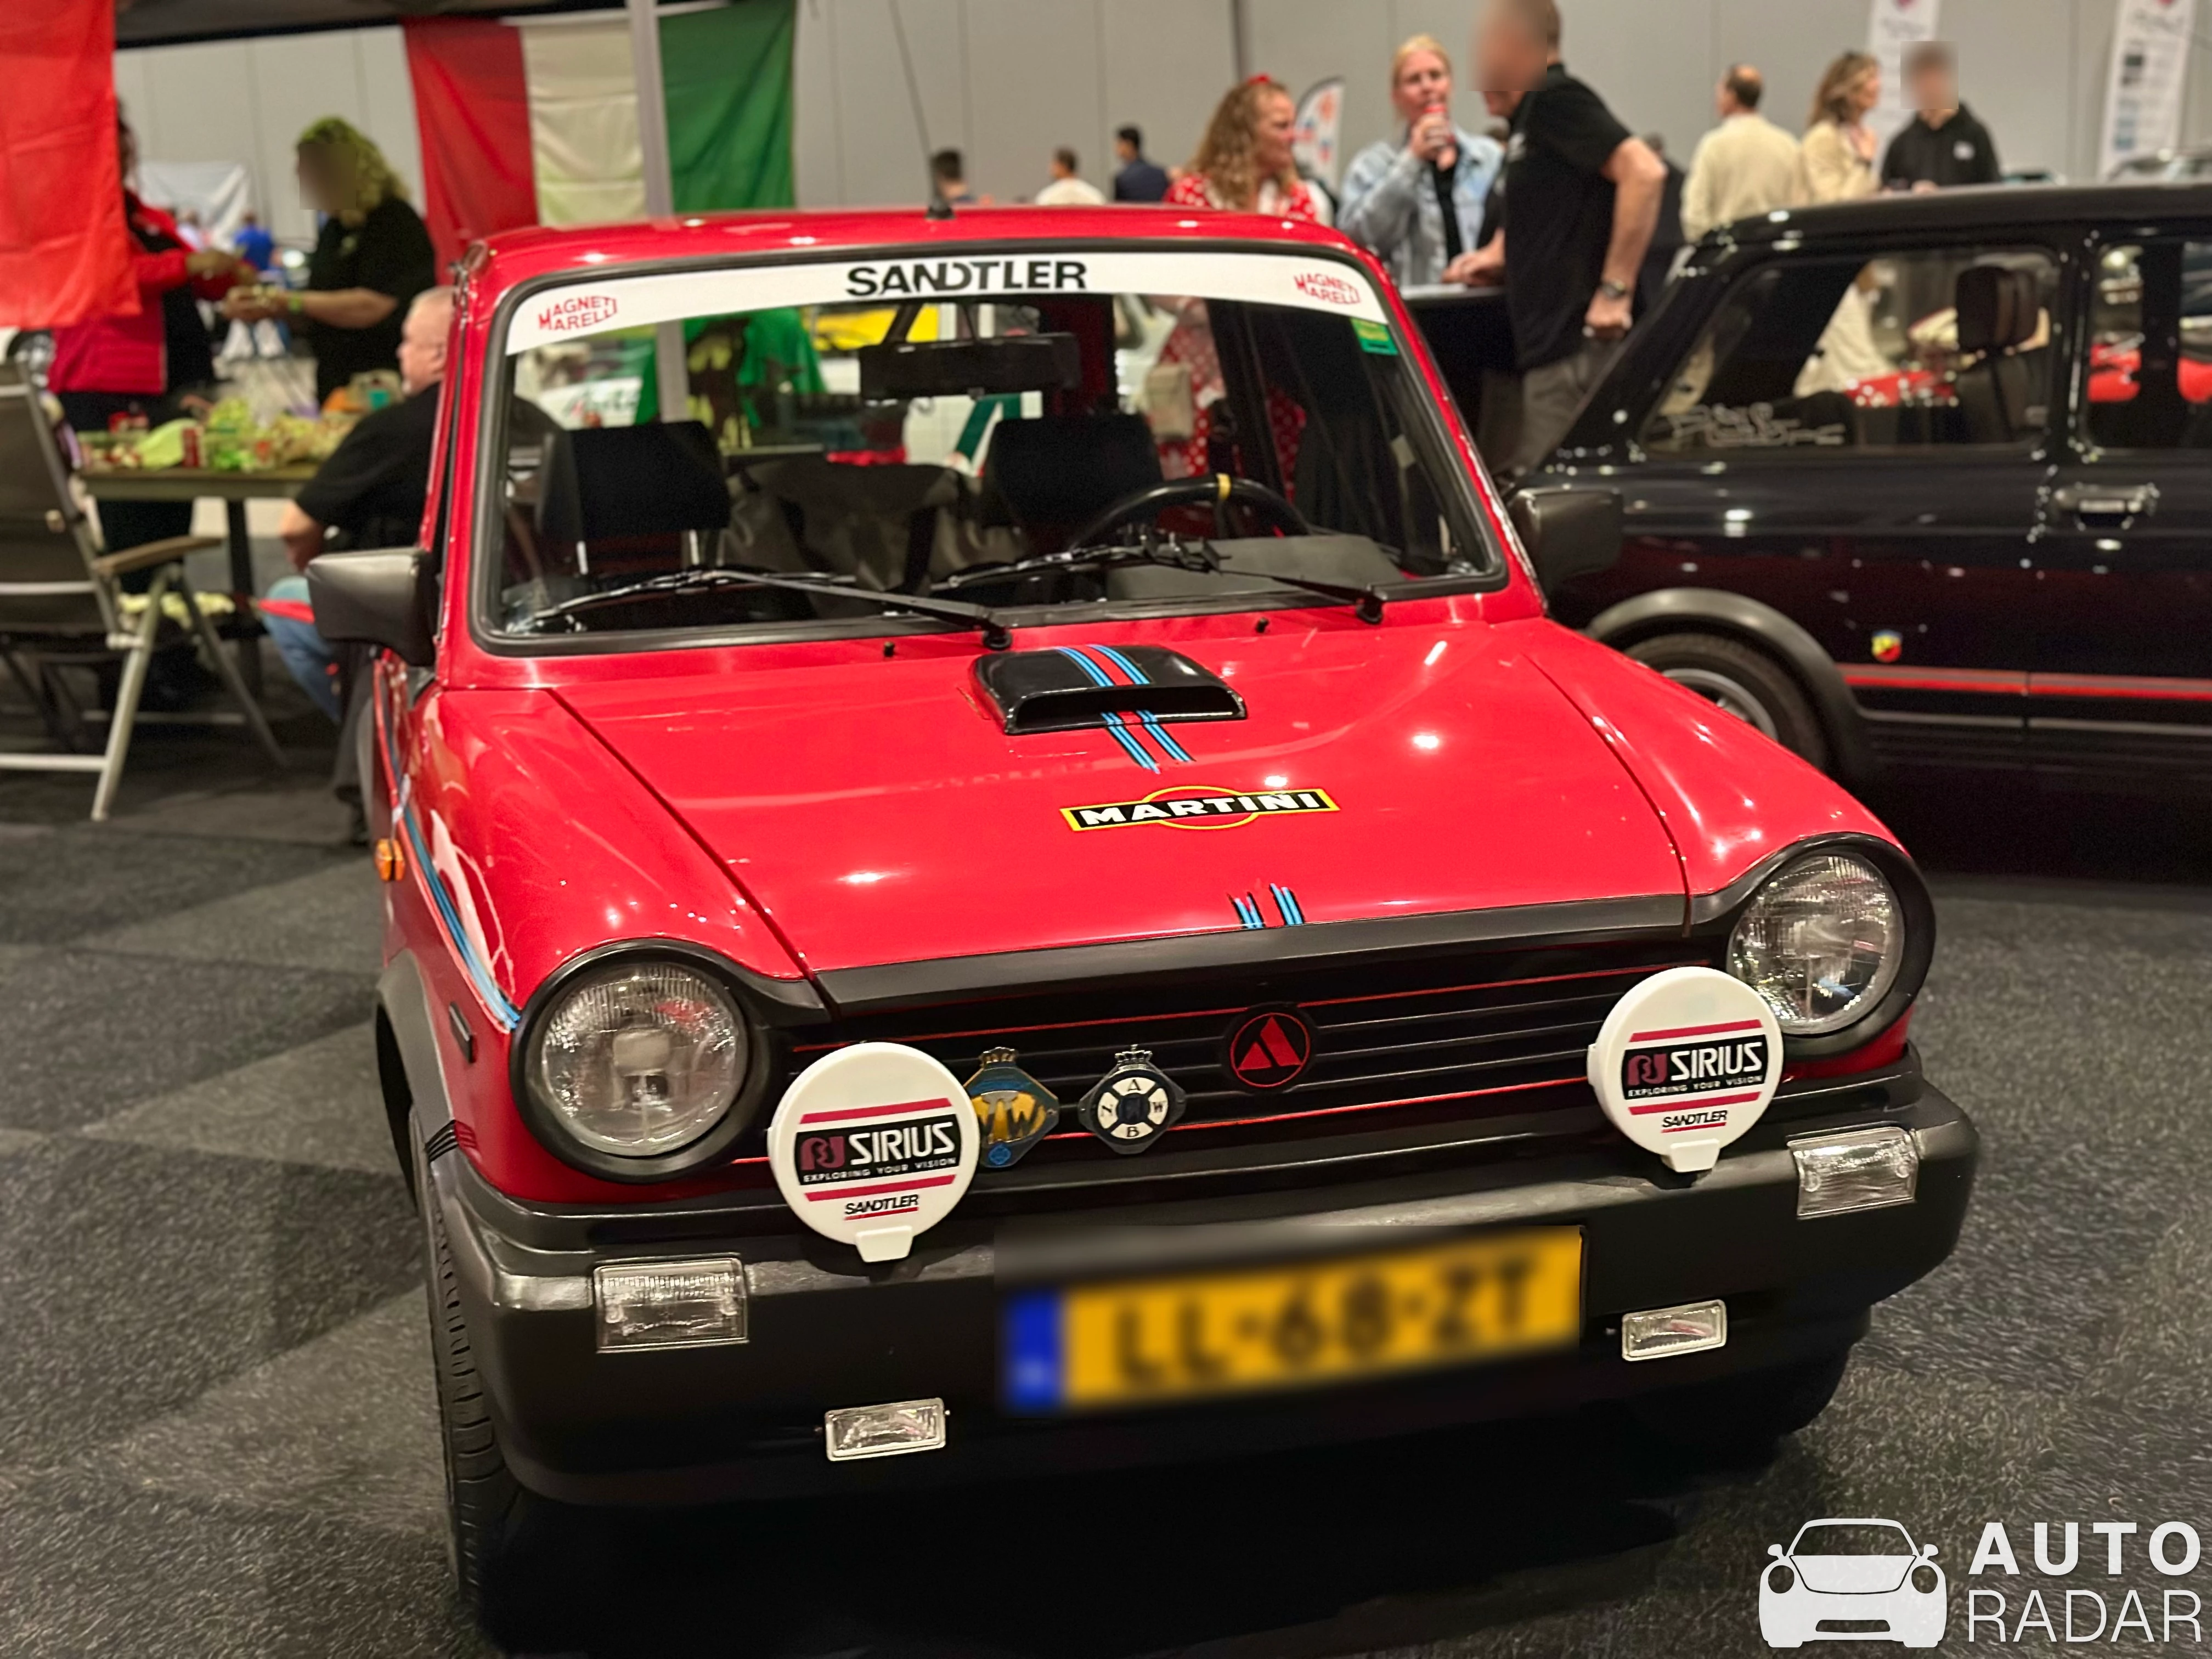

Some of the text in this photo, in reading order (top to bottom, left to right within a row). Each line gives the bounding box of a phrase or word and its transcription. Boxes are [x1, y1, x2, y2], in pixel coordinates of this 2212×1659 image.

[845, 261, 1087, 297] SANDTLER
[1079, 793, 1320, 825] MARTINI
[1671, 1042, 1763, 1081] SIRIUS
[1628, 1075, 1763, 1097] EXPLORING YOUR VISION
[1662, 1110, 1728, 1128] SANDTLER
[849, 1122, 955, 1165] SIRIUS
[804, 1158, 956, 1182] EXPLORING YOUR VISION
[845, 1195, 918, 1215] SANDTLER
